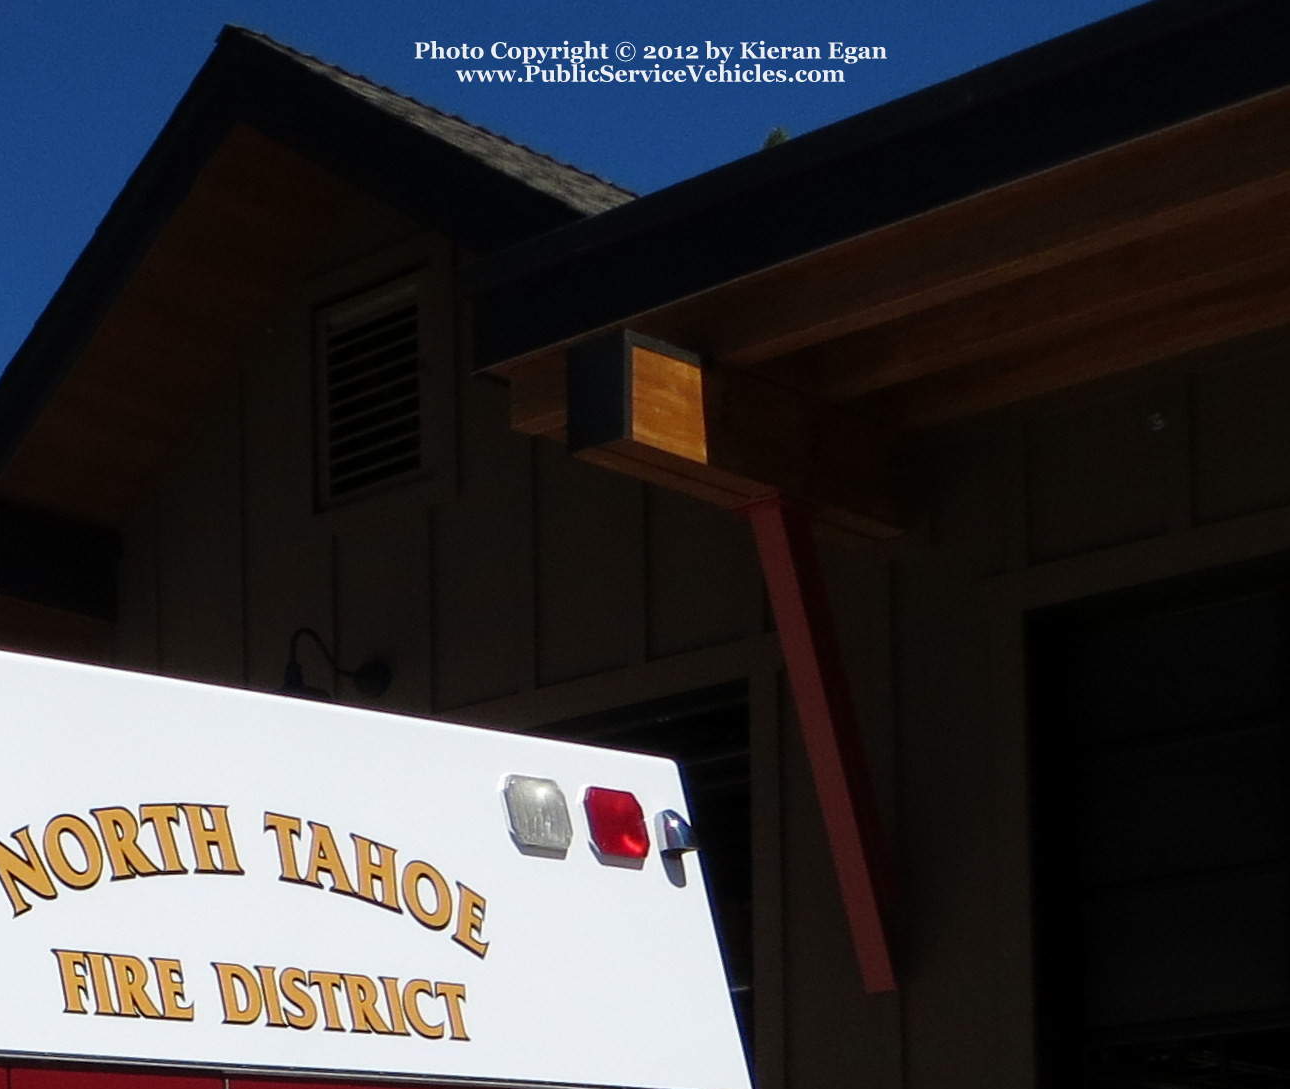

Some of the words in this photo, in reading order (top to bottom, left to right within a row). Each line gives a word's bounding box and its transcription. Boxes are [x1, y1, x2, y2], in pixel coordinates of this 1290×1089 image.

[263, 811, 490, 959] TAHOE
[51, 948, 195, 1022] FIRE
[210, 961, 471, 1041] DISTRICT
